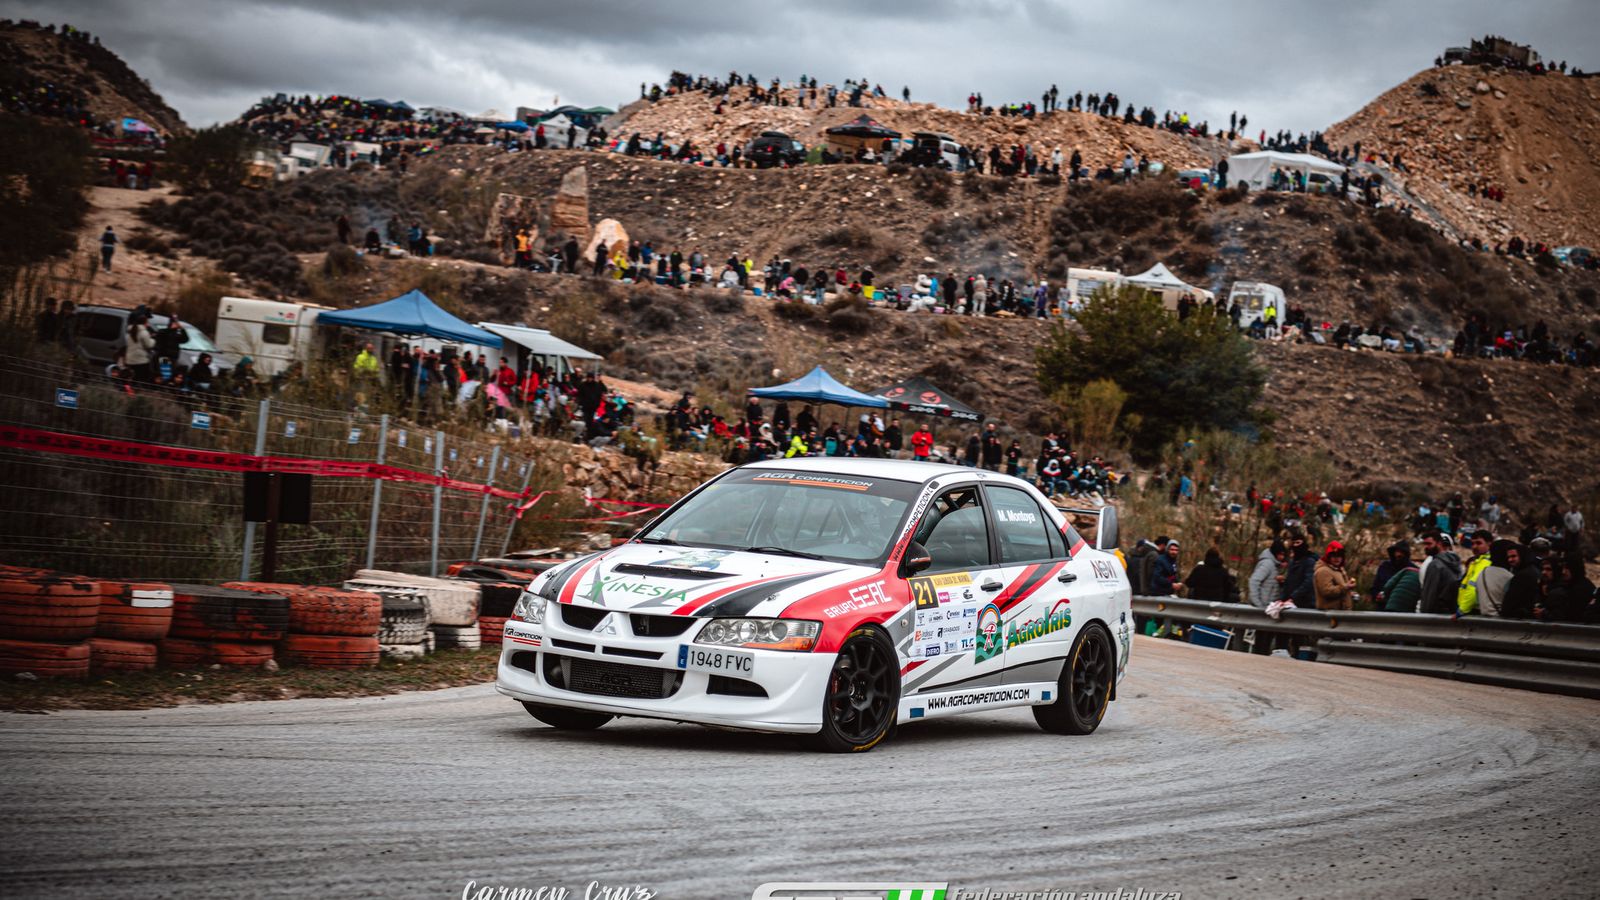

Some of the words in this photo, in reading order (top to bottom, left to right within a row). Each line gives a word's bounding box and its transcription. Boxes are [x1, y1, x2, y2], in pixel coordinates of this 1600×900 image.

[796, 475, 874, 487] COMPETICION
[823, 602, 858, 618] GRUPO
[848, 580, 893, 609] SEAC
[914, 581, 933, 606] 21
[691, 650, 722, 668] 1948
[725, 655, 752, 672] FVC
[927, 689, 1030, 710] WWW.AGRCOMPETICION.COM
